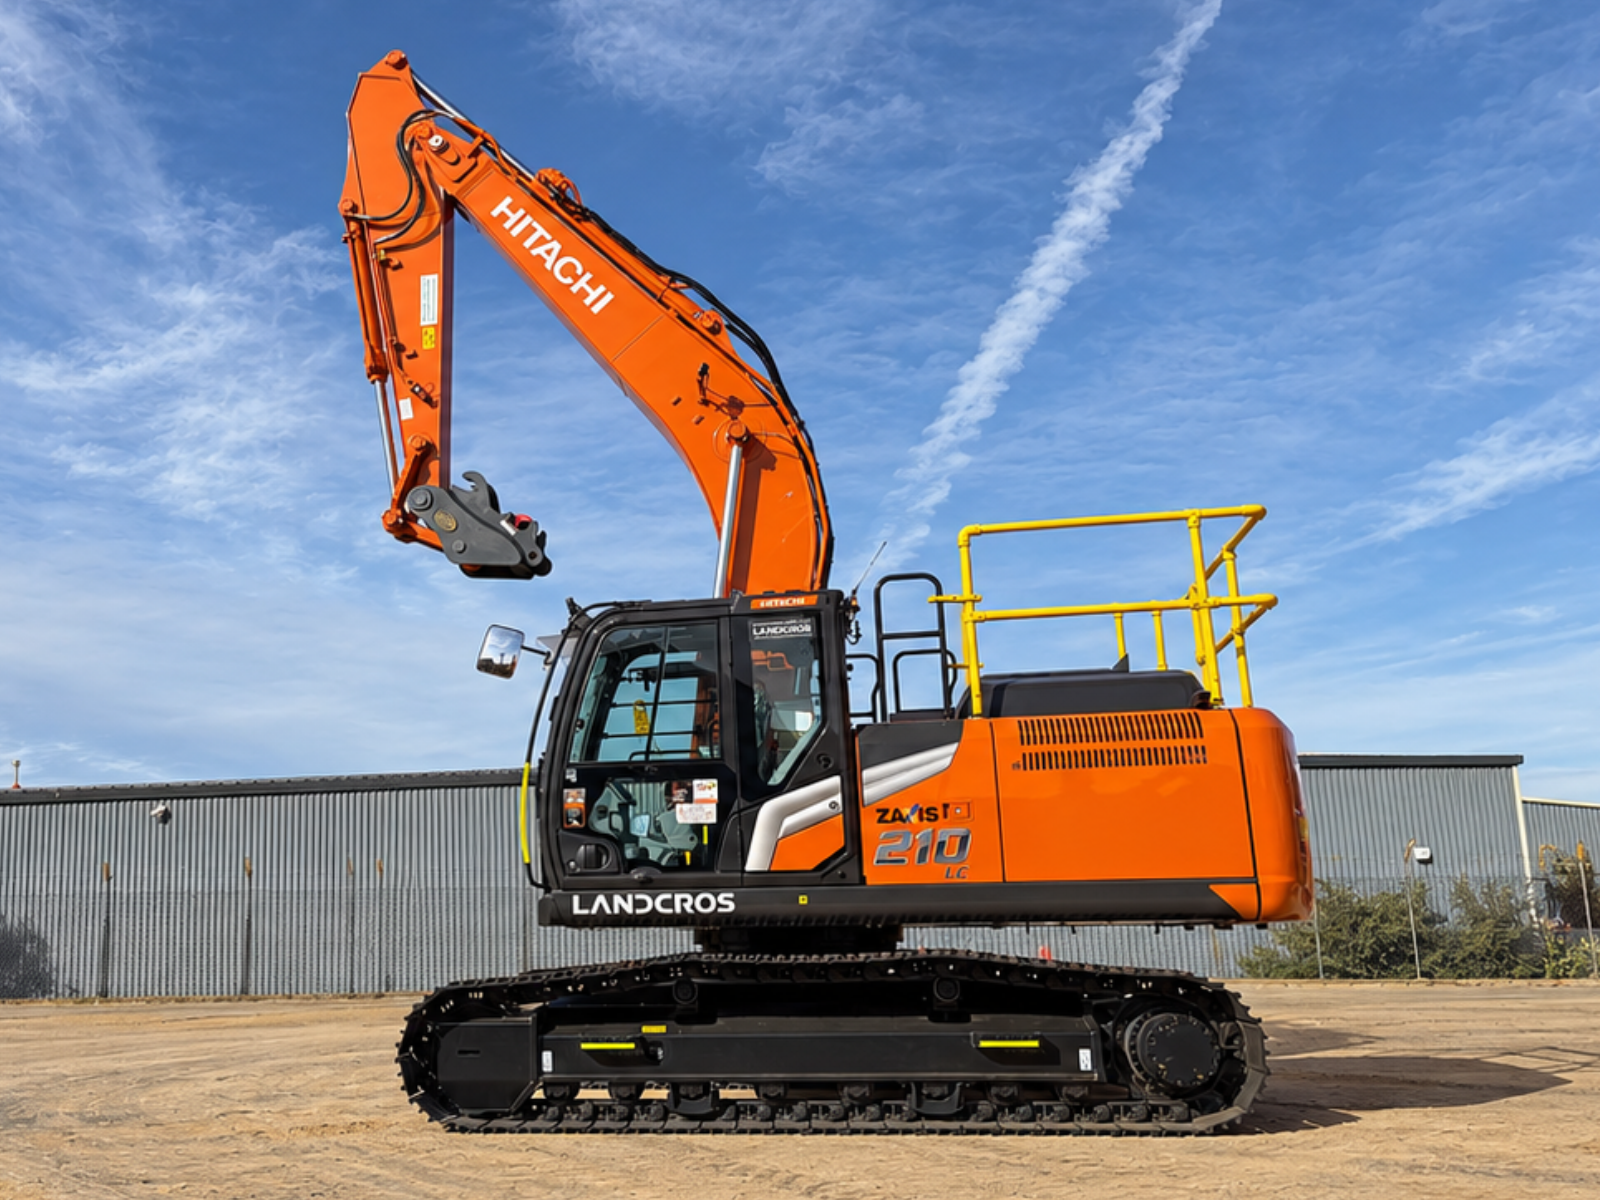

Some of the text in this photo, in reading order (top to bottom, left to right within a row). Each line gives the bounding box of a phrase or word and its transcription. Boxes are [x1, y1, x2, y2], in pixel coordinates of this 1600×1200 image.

[490, 195, 615, 314] HITACHI
[873, 827, 972, 866] 210
[944, 864, 970, 879] LC
[572, 893, 736, 915] LANDCROS
